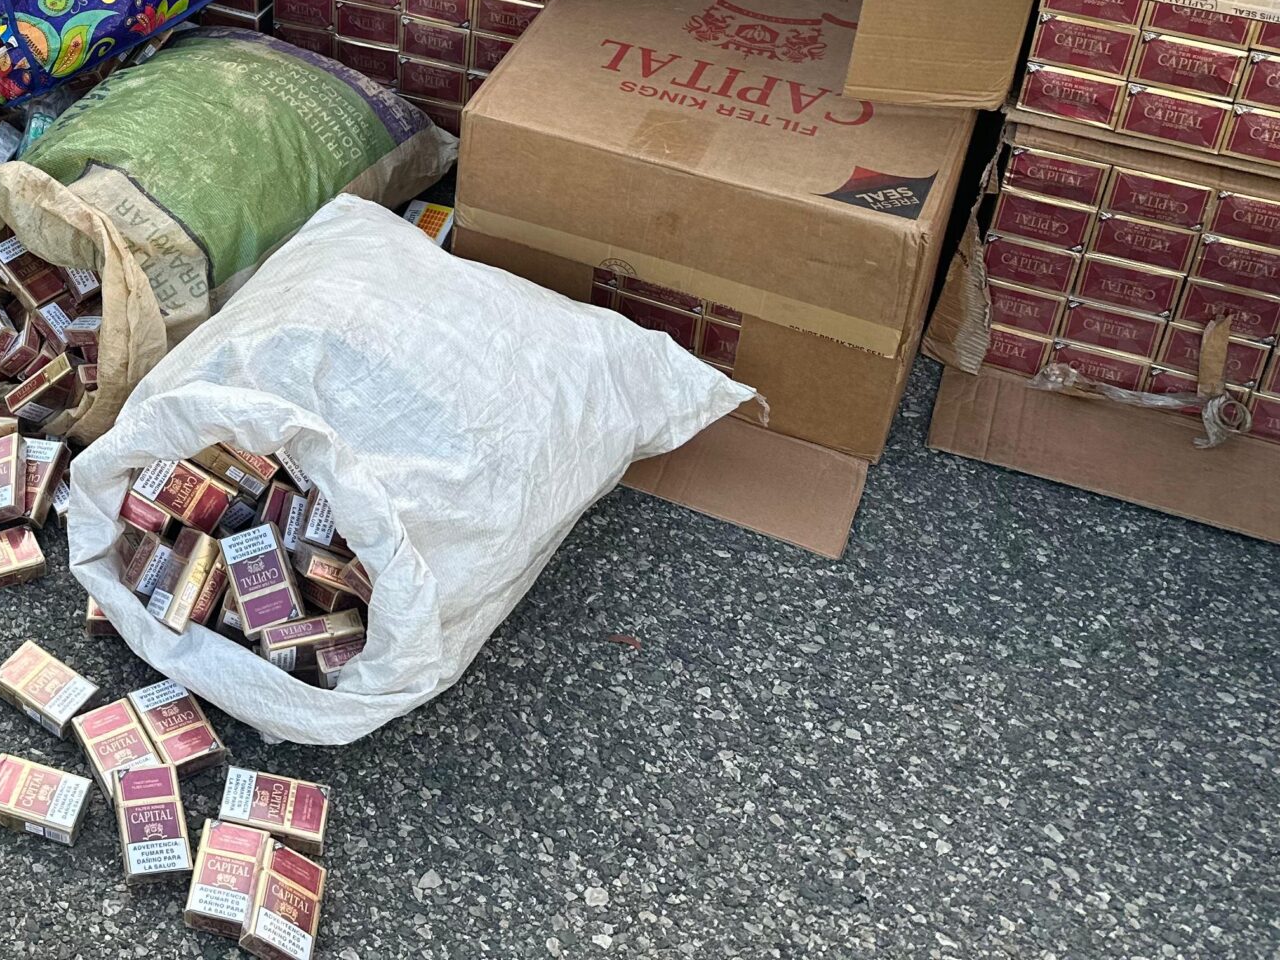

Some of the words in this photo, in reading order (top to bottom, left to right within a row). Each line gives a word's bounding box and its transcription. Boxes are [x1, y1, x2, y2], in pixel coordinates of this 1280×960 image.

[1233, 7, 1258, 20] SEAL
[1055, 33, 1112, 54] CAPITAL
[1158, 54, 1218, 77] CAPITAL
[600, 38, 875, 126] CAPITAL
[619, 80, 707, 110] KINGS
[1042, 84, 1098, 106] CAPITAL
[717, 104, 818, 137] FILTER
[1144, 105, 1203, 129] CAPITAL
[1027, 167, 1082, 188] CAPITAL
[855, 187, 913, 202] SEAL
[871, 197, 919, 210] FRESH
[1130, 190, 1188, 213] CAPITAL
[1114, 231, 1170, 253] CAPITAL
[1001, 252, 1056, 274] CAPITAL
[171, 476, 198, 510] CAPITAL
[240, 567, 279, 584] CAPITAL
[279, 623, 313, 639] CAPITAL
[156, 710, 195, 731] CAPITAL
[98, 733, 139, 755] CAPITAL
[21, 774, 44, 807] CAPITAL
[270, 783, 284, 819] CAPITAL
[131, 809, 173, 824] CAPITAL
[154, 861, 176, 870] SALUD
[164, 854, 181, 862] PARA
[207, 859, 250, 878] CAPITAL
[271, 884, 310, 914] CAPITAL
